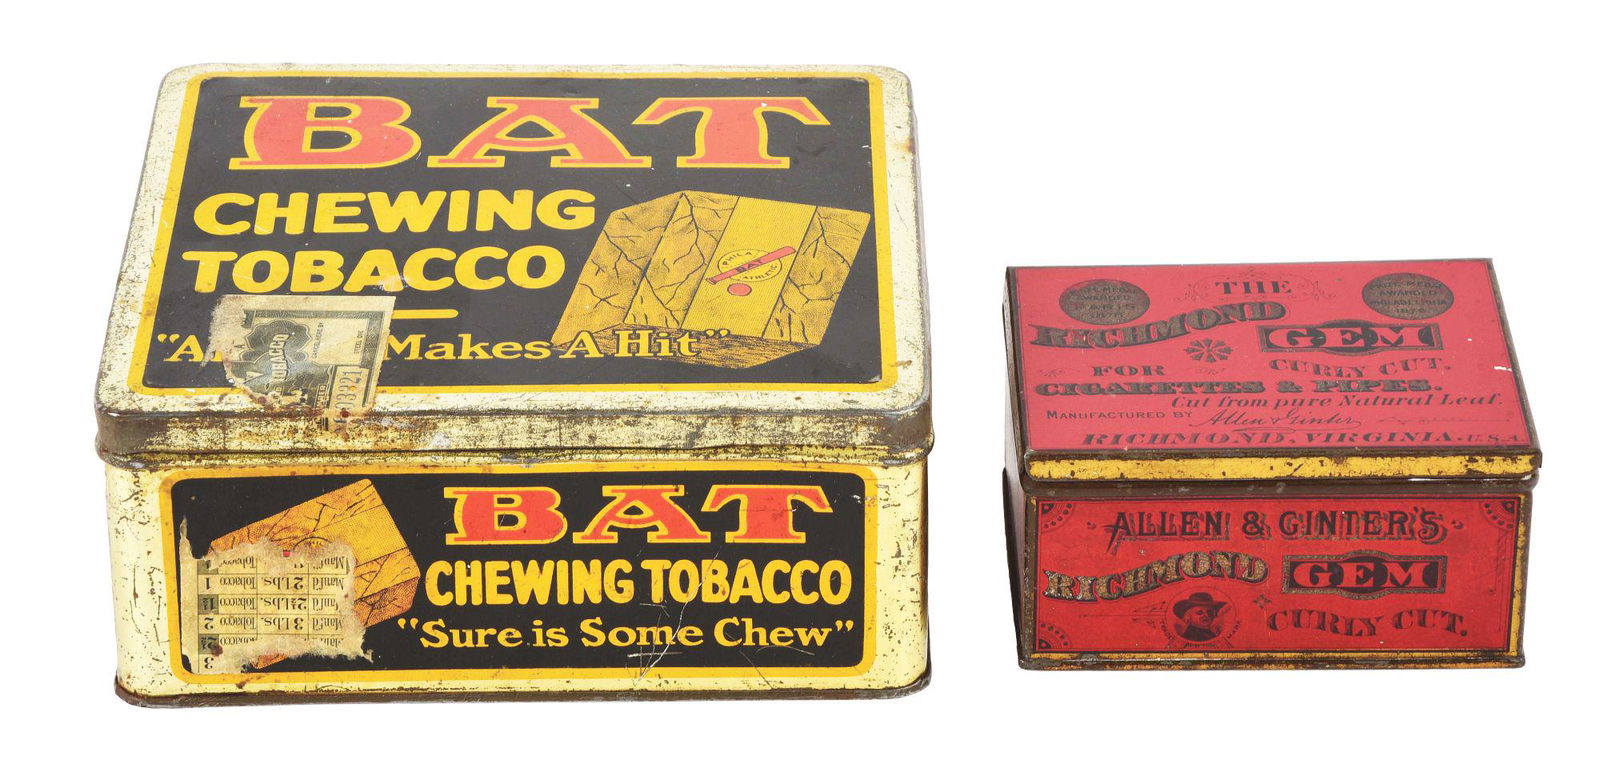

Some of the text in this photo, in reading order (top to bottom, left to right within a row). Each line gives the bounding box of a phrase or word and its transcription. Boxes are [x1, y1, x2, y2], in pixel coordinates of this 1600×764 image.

[228, 95, 831, 170] BAT
[193, 189, 596, 236] CHEWING
[181, 246, 566, 293] TOBACCO
[1215, 279, 1293, 295] THE
[1027, 300, 1434, 350] RICHMOND GEM
[384, 333, 552, 361] Makes
[559, 331, 604, 359] A
[613, 328, 730, 358] Hit”
[1092, 364, 1166, 377] FOR
[1270, 356, 1453, 378] CURLY CUT.
[1313, 379, 1444, 393] PIPES.
[1171, 393, 1503, 411] Cut from pure Natural Leaf.
[1046, 409, 1193, 420] MANUFACTURED BY
[443, 484, 834, 547] BAT
[1102, 506, 1448, 556] ALLEN & GINTER'S
[204, 577, 212, 590] 1
[219, 576, 257, 591] Tobacco
[261, 576, 291, 591] Lbs.
[293, 576, 304, 590] 2
[425, 558, 853, 607] CHEWING TOBACCO
[1042, 550, 1431, 604] RICHMOND GEM
[219, 597, 257, 611] Tobacco
[204, 616, 214, 630] 2
[219, 616, 257, 631] Tobacco
[261, 616, 290, 631] Lbs.
[293, 617, 304, 631] 3
[1267, 607, 1468, 638] CURLY CUT.
[533, 617, 568, 648] is
[580, 616, 704, 648] Some
[204, 656, 214, 670] 3
